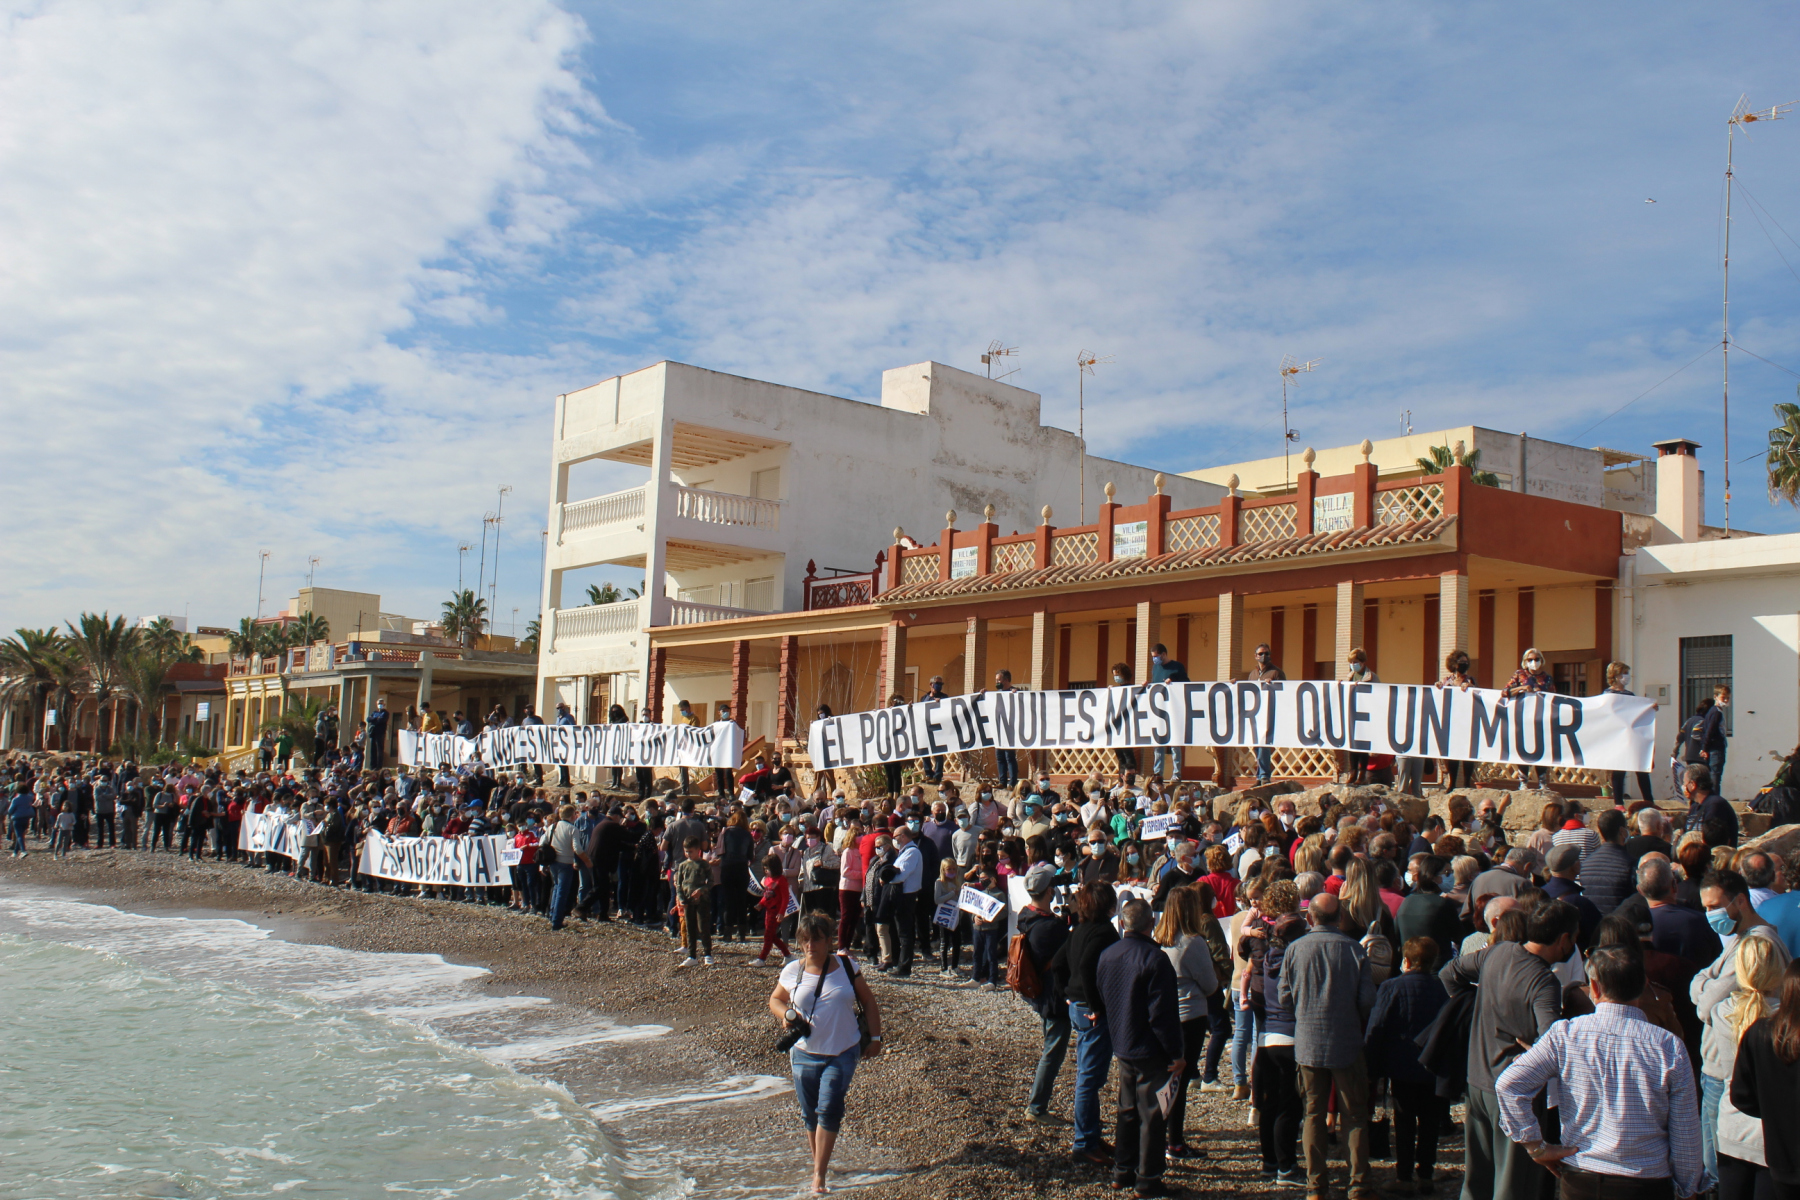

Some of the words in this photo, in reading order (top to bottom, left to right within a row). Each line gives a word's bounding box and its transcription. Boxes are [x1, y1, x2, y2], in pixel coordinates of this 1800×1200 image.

[1318, 515, 1350, 532] CARMEN
[1322, 496, 1348, 512] VILLA
[413, 731, 432, 767] EL
[491, 726, 537, 769] NULES
[539, 725, 570, 765] MES
[572, 724, 612, 765] FORT
[612, 724, 638, 765] QUE
[640, 724, 669, 766] UN
[821, 717, 854, 768] EL
[859, 701, 949, 764] POBLE
[951, 694, 995, 751] DE
[995, 690, 1097, 748] NULES
[1183, 682, 1284, 745] FORT
[1296, 682, 1373, 751] QUE
[1387, 685, 1453, 757] UN
[1469, 690, 1585, 766] MUR
[464, 837, 500, 883] YA!
